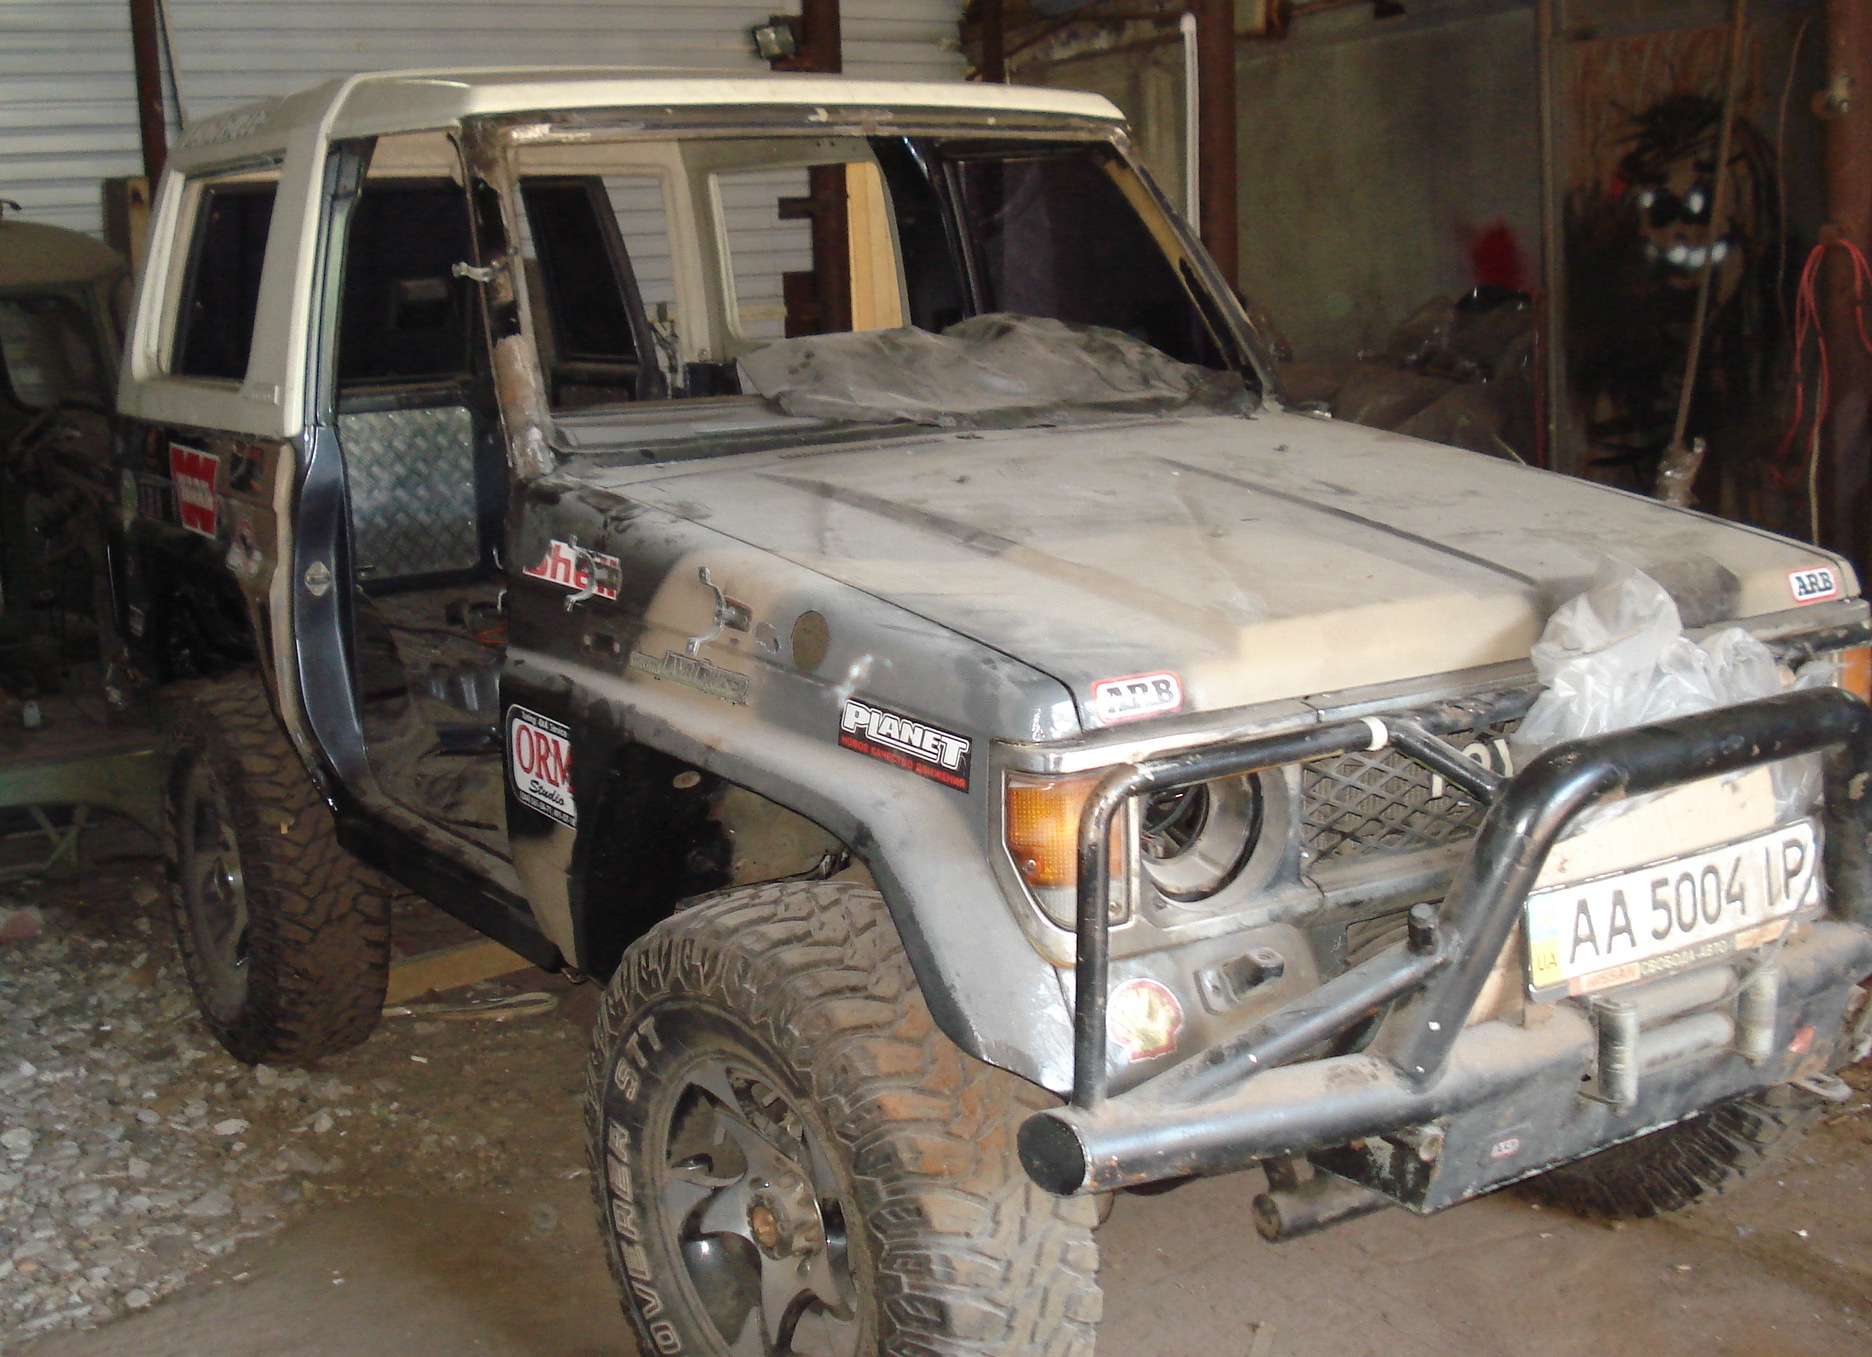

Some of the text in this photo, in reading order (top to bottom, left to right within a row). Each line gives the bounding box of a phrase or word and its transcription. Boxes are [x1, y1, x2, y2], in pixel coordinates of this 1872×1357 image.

[1795, 571, 1833, 597] ARB
[841, 699, 970, 770] PLANET
[529, 779, 565, 806] Studio
[1569, 888, 1637, 965] AA
[1650, 856, 1746, 941] 5004
[1764, 837, 1806, 906] IP
[1537, 952, 1558, 972] UA
[613, 1015, 663, 1100] STT
